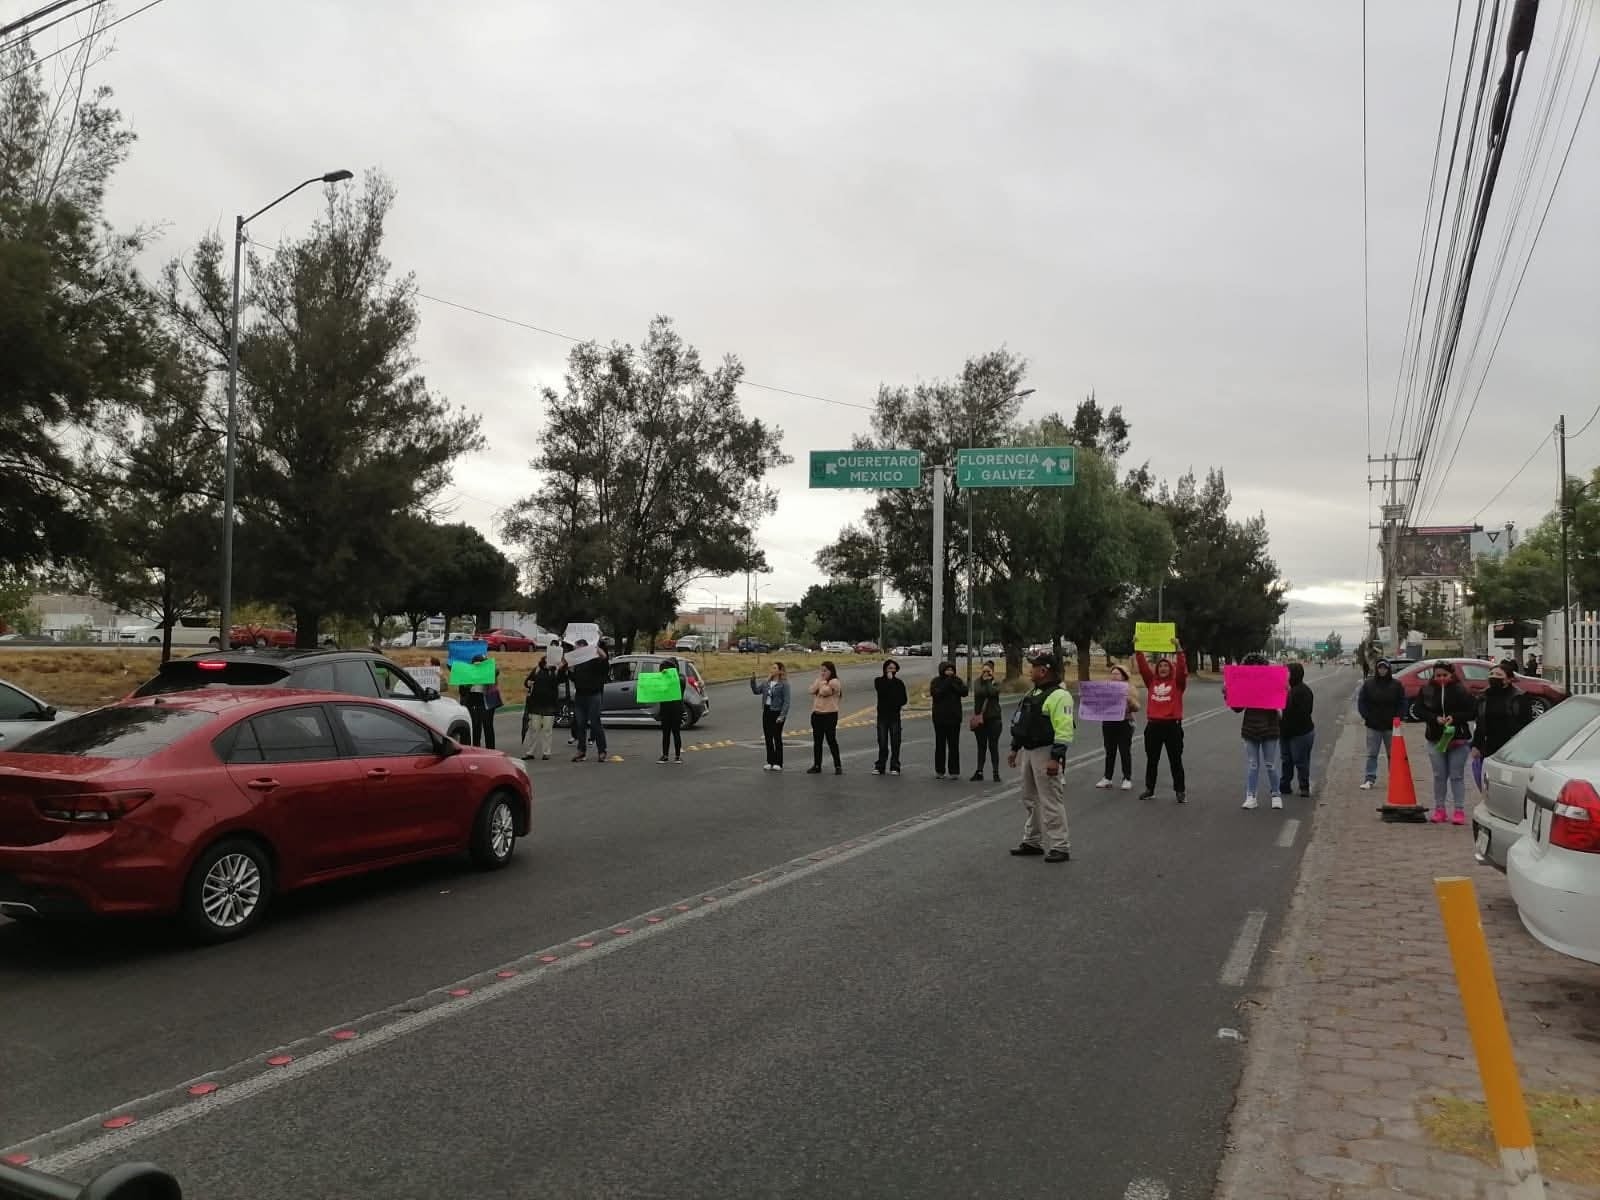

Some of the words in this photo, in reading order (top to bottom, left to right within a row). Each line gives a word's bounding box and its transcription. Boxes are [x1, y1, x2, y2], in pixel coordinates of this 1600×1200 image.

[838, 456, 918, 467] QUERETARO
[960, 453, 1039, 465] FLORENCIA
[850, 471, 903, 482] MEXICO
[964, 471, 975, 481] J.
[982, 470, 1035, 480] GALVEZ
